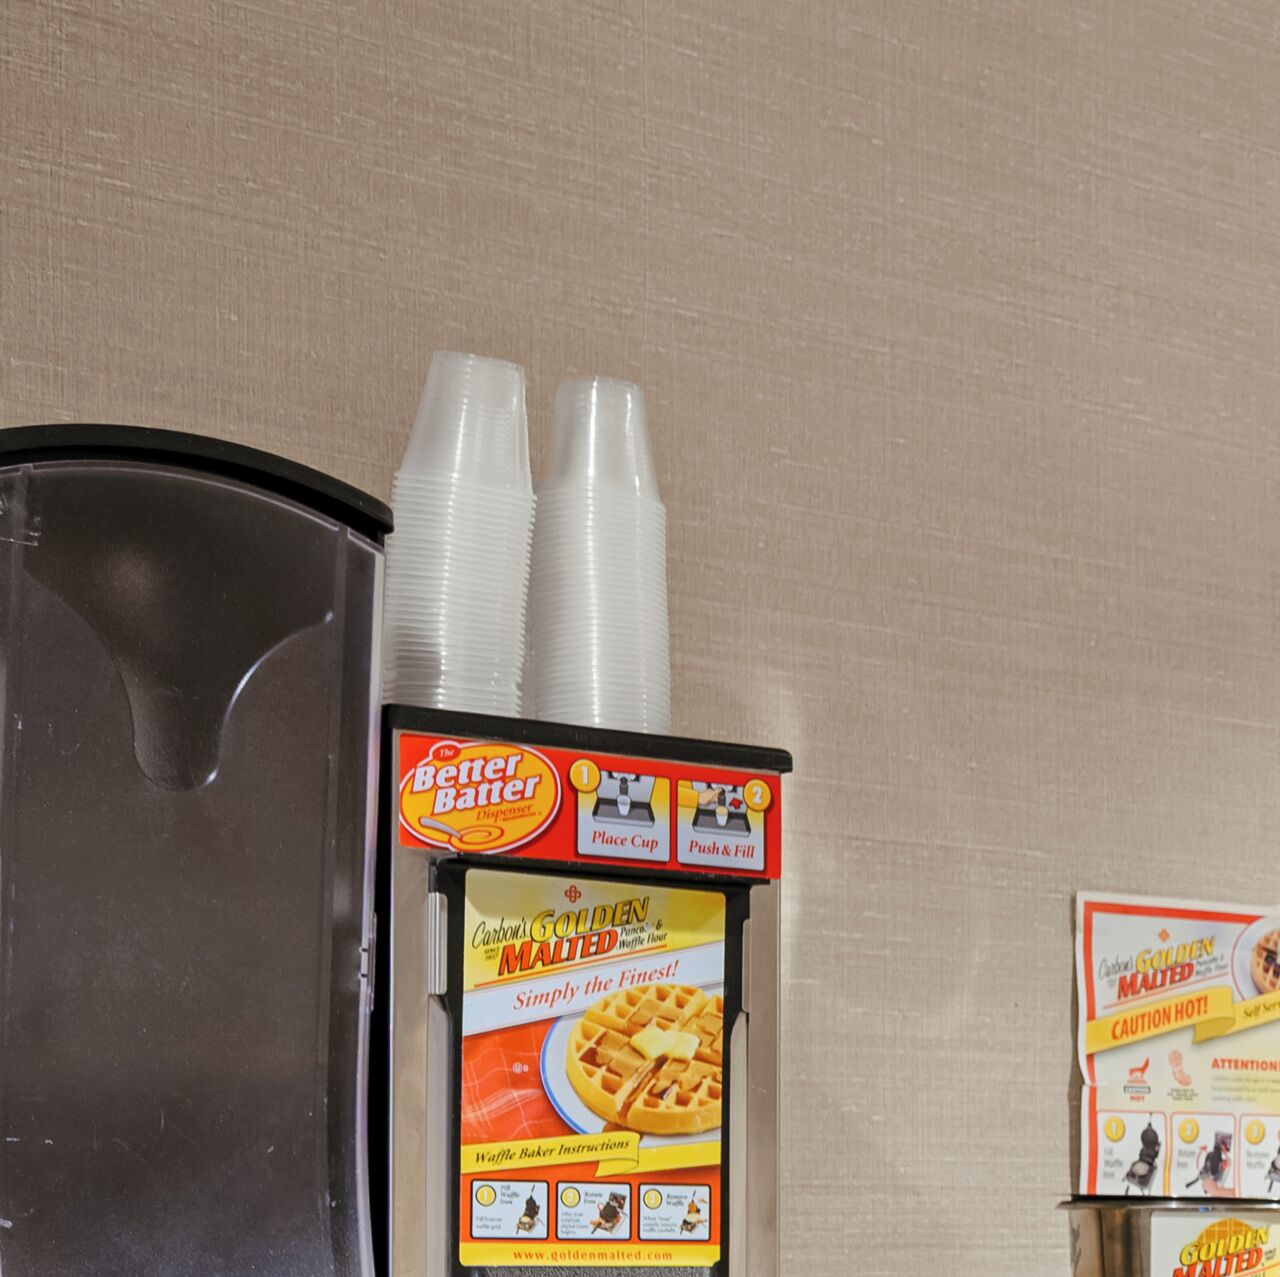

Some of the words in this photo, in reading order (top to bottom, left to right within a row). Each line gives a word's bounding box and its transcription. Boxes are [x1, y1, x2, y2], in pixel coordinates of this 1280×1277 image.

[439, 749, 455, 758] The
[412, 754, 522, 792] Better
[582, 766, 588, 785] 1
[433, 776, 540, 814] Batter
[751, 787, 763, 804] 2
[476, 803, 534, 823] Dispenser
[592, 831, 627, 846] Place
[630, 835, 659, 853] Cup
[689, 840, 720, 855] Push
[721, 845, 732, 857] &
[734, 845, 756, 859] Fill
[472, 917, 527, 949] Carbon's
[530, 897, 650, 943] GOLDEN
[498, 929, 618, 976] MALTED
[618, 936, 645, 950] Waffle
[1135, 934, 1215, 974] GOLDEN
[513, 982, 579, 1010] Simply
[584, 976, 613, 996] the
[618, 960, 680, 988] Finest!
[1117, 962, 1194, 1000] MALTED
[1111, 1004, 1171, 1040] CAUTION
[1174, 995, 1208, 1023] HOT!
[1243, 1005, 1261, 1021] Self
[475, 1149, 517, 1165] Waffle
[518, 1147, 554, 1160] Baker
[557, 1139, 630, 1156] Instructions
[513, 1249, 673, 1262] www.goldenmalted.com
[1180, 1225, 1270, 1267] GOLDEN
